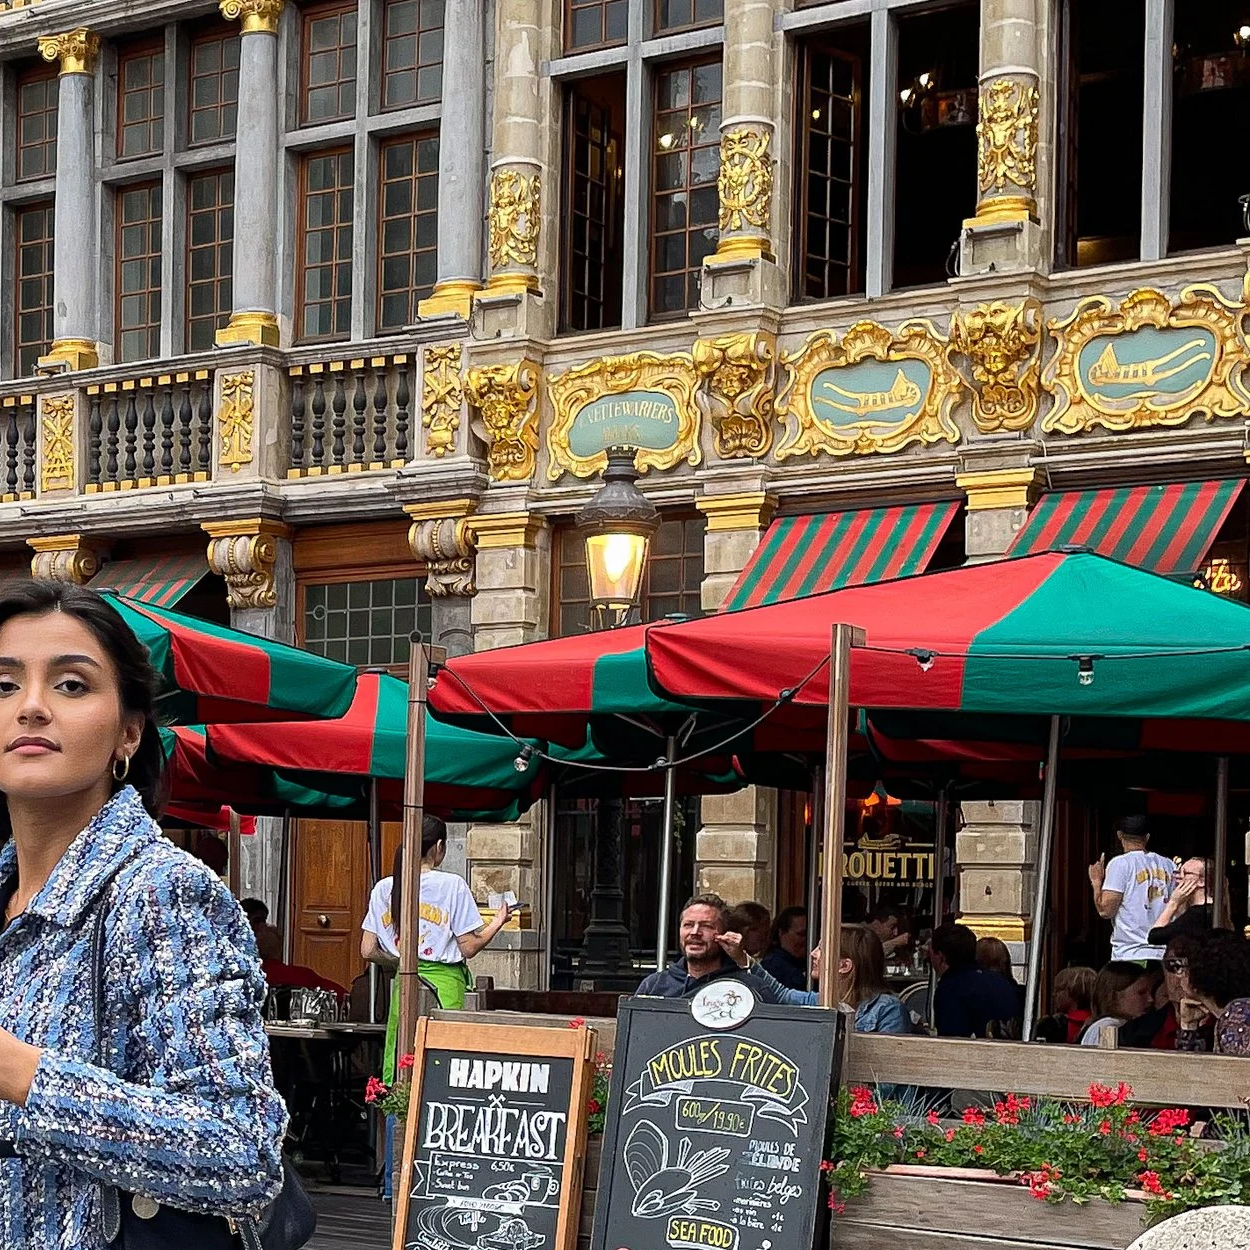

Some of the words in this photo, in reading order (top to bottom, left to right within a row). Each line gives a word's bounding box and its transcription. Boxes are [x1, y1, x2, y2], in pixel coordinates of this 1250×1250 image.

[449, 1058, 551, 1094] HAPKIN
[651, 1040, 722, 1085] MOULES
[729, 1042, 797, 1098] FRITES
[434, 1154, 480, 1171] Express
[783, 1142, 797, 1157] DE
[766, 1175, 802, 1205] belges
[669, 1220, 696, 1242] SEA
[699, 1224, 733, 1248] FOOD
